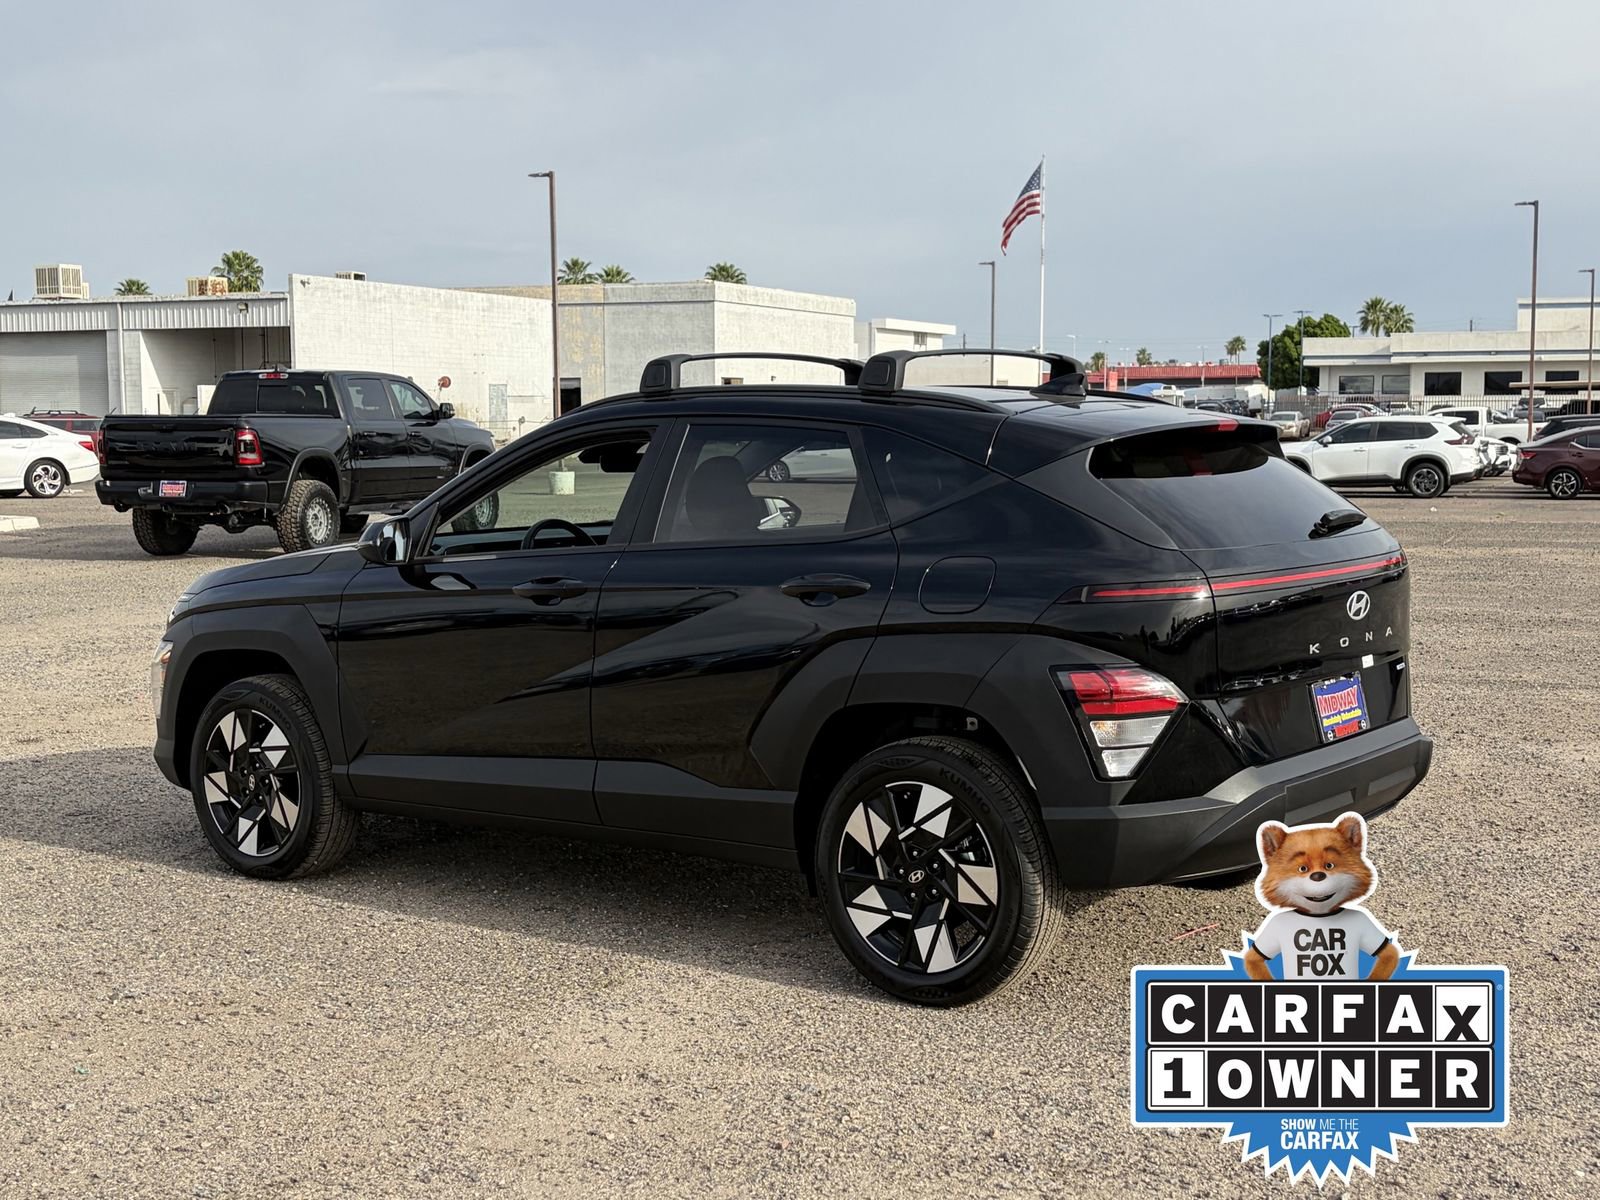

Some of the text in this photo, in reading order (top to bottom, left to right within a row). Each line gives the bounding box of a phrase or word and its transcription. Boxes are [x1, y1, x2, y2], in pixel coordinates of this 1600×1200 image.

[1309, 626, 1393, 655] KONA
[1317, 685, 1359, 717] MIDWAY
[939, 768, 991, 814] KUMHO
